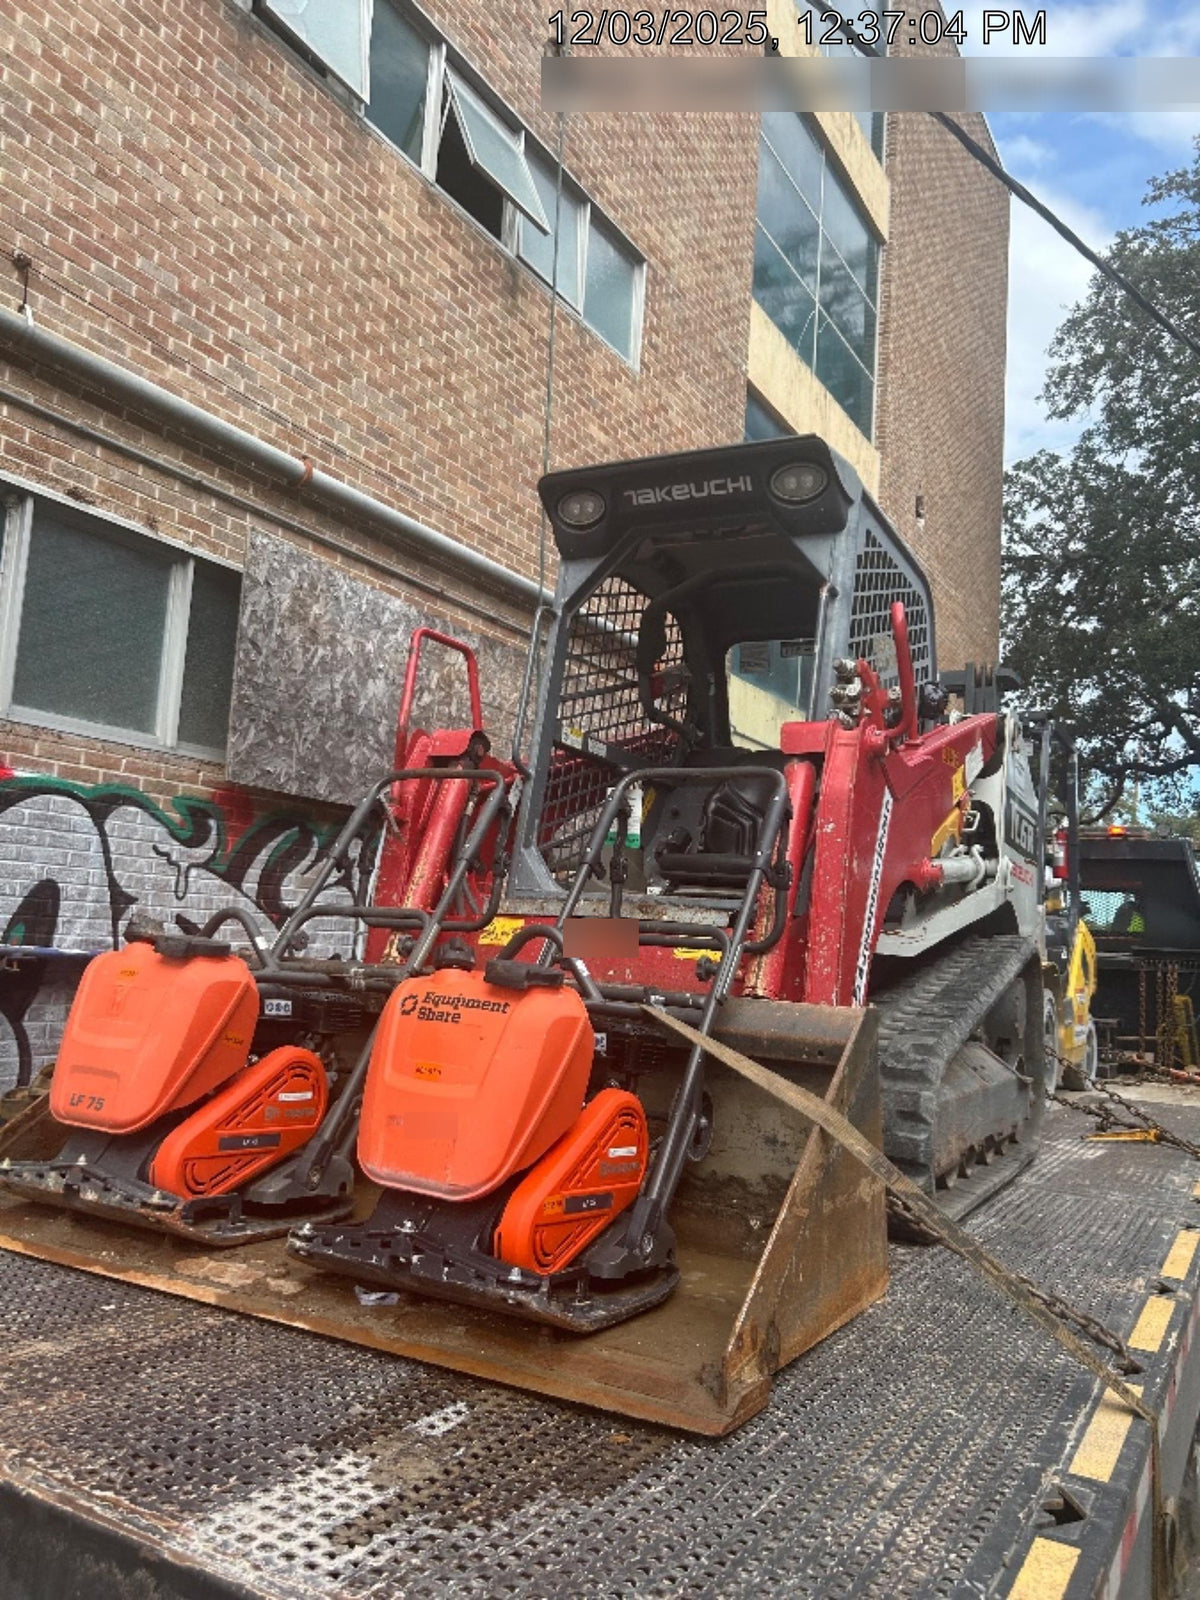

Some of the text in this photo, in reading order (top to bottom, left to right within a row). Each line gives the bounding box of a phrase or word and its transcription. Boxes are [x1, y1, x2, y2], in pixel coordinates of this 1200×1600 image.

[623, 475, 752, 505] TAKEUCHI
[421, 990, 511, 1014] Equipment
[417, 1005, 461, 1024] Share
[69, 1093, 106, 1112] LF 75
